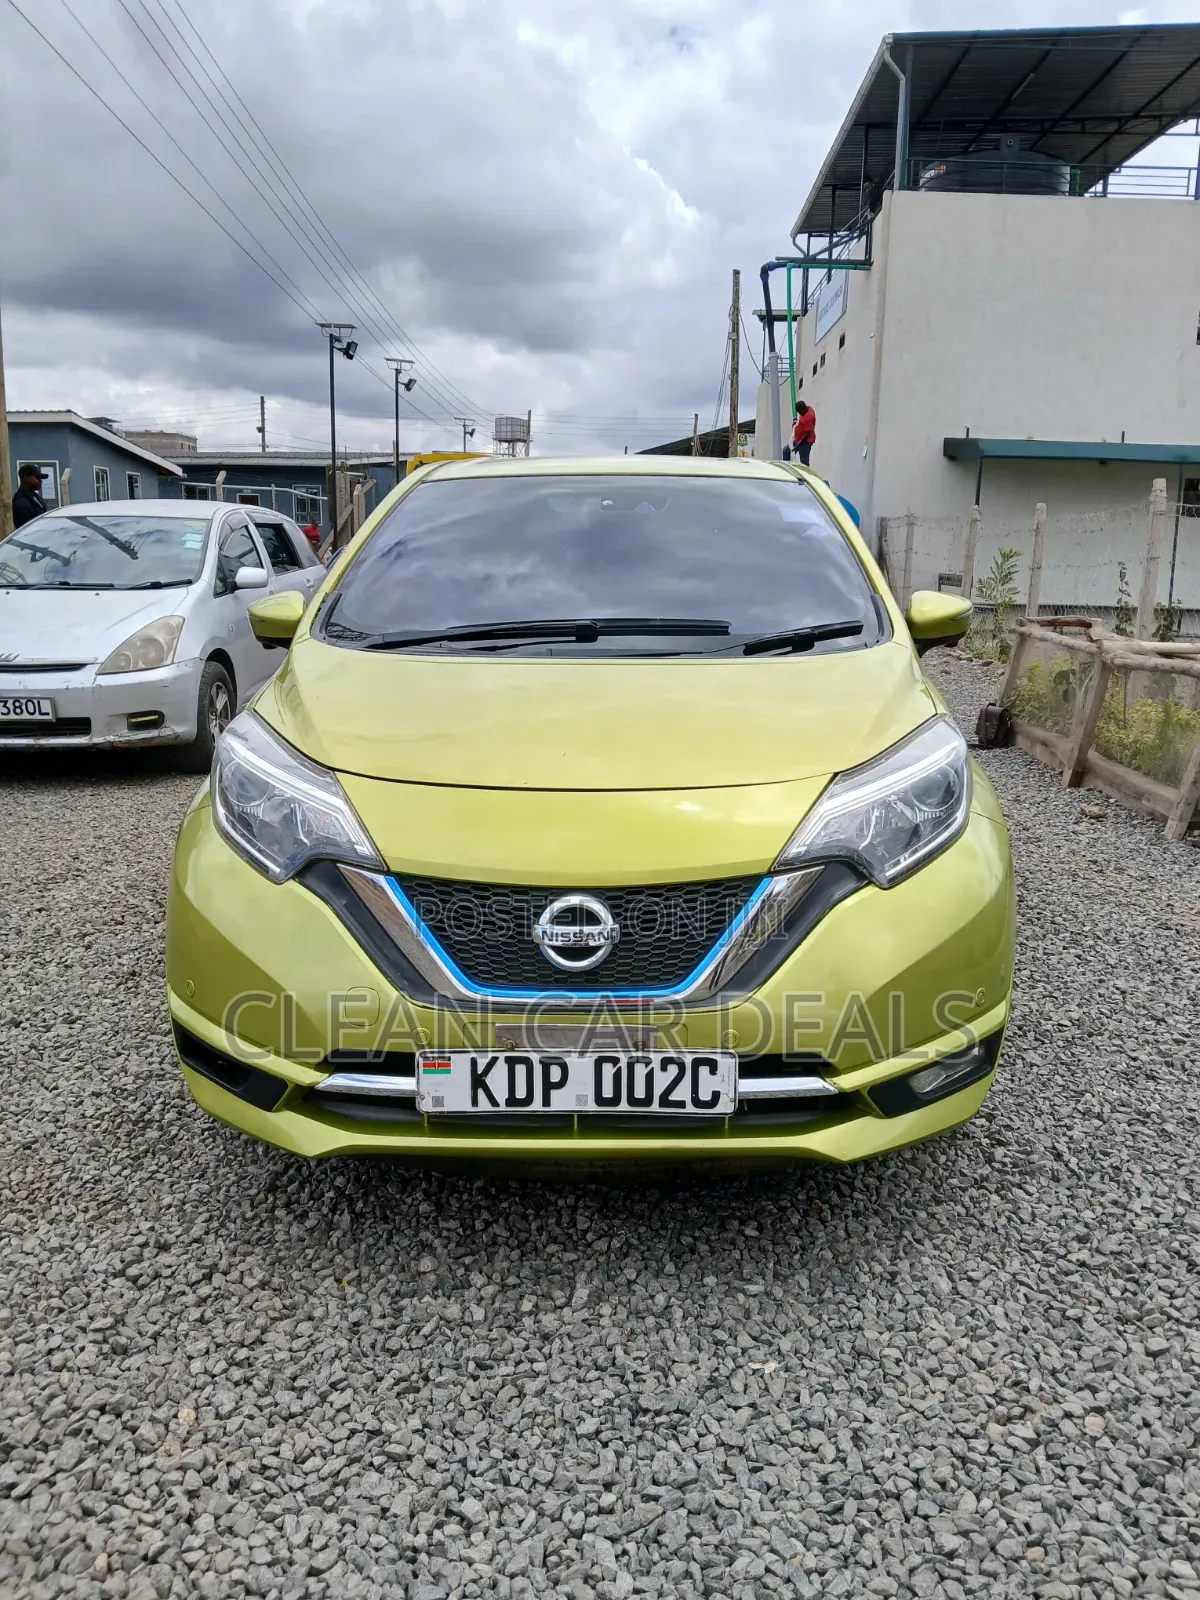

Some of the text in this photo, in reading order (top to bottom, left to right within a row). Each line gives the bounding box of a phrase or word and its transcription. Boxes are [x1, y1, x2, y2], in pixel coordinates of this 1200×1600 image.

[0, 698, 50, 716] 380L
[541, 930, 610, 942] NISSAN
[470, 1055, 569, 1108] KDP
[594, 1055, 721, 1109] 002C
